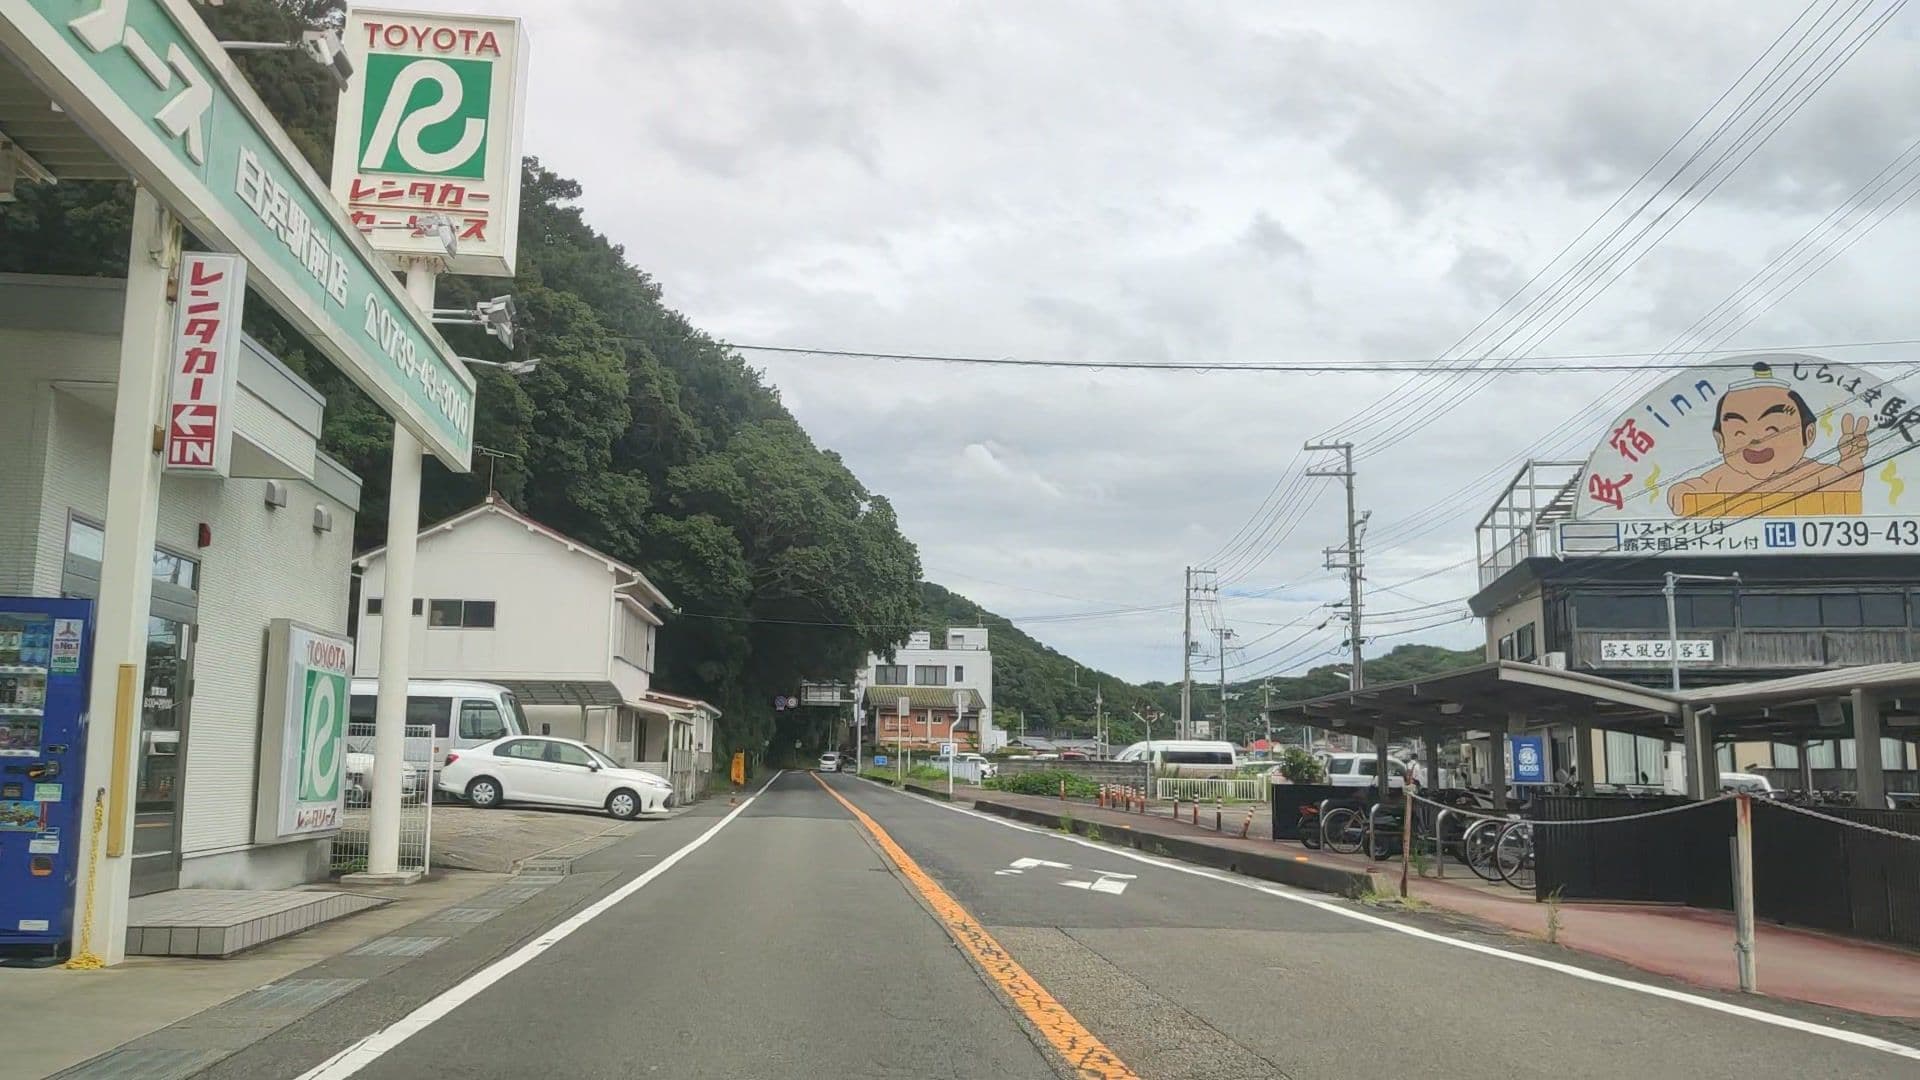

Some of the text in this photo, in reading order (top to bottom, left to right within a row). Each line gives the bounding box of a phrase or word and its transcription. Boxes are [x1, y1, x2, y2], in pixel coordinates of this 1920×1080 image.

[363, 22, 502, 58] TOYOTA
[350, 178, 490, 206] レンタカー
[235, 144, 349, 309] 白浜駅前店
[350, 210, 488, 243] カーリス
[182, 261, 224, 401] レンタカー
[379, 308, 469, 436] 0739-43-3000
[171, 440, 212, 463] IN
[1588, 417, 1656, 511] 民宿
[1645, 379, 1717, 428] inn
[1623, 521, 1725, 536] バス・トイレ付
[1623, 536, 1759, 551] 露天風呂・トイレ付
[1765, 523, 1796, 547] TEL
[306, 640, 347, 670] TOYOTA
[1602, 642, 1711, 658] 露天風呂客室
